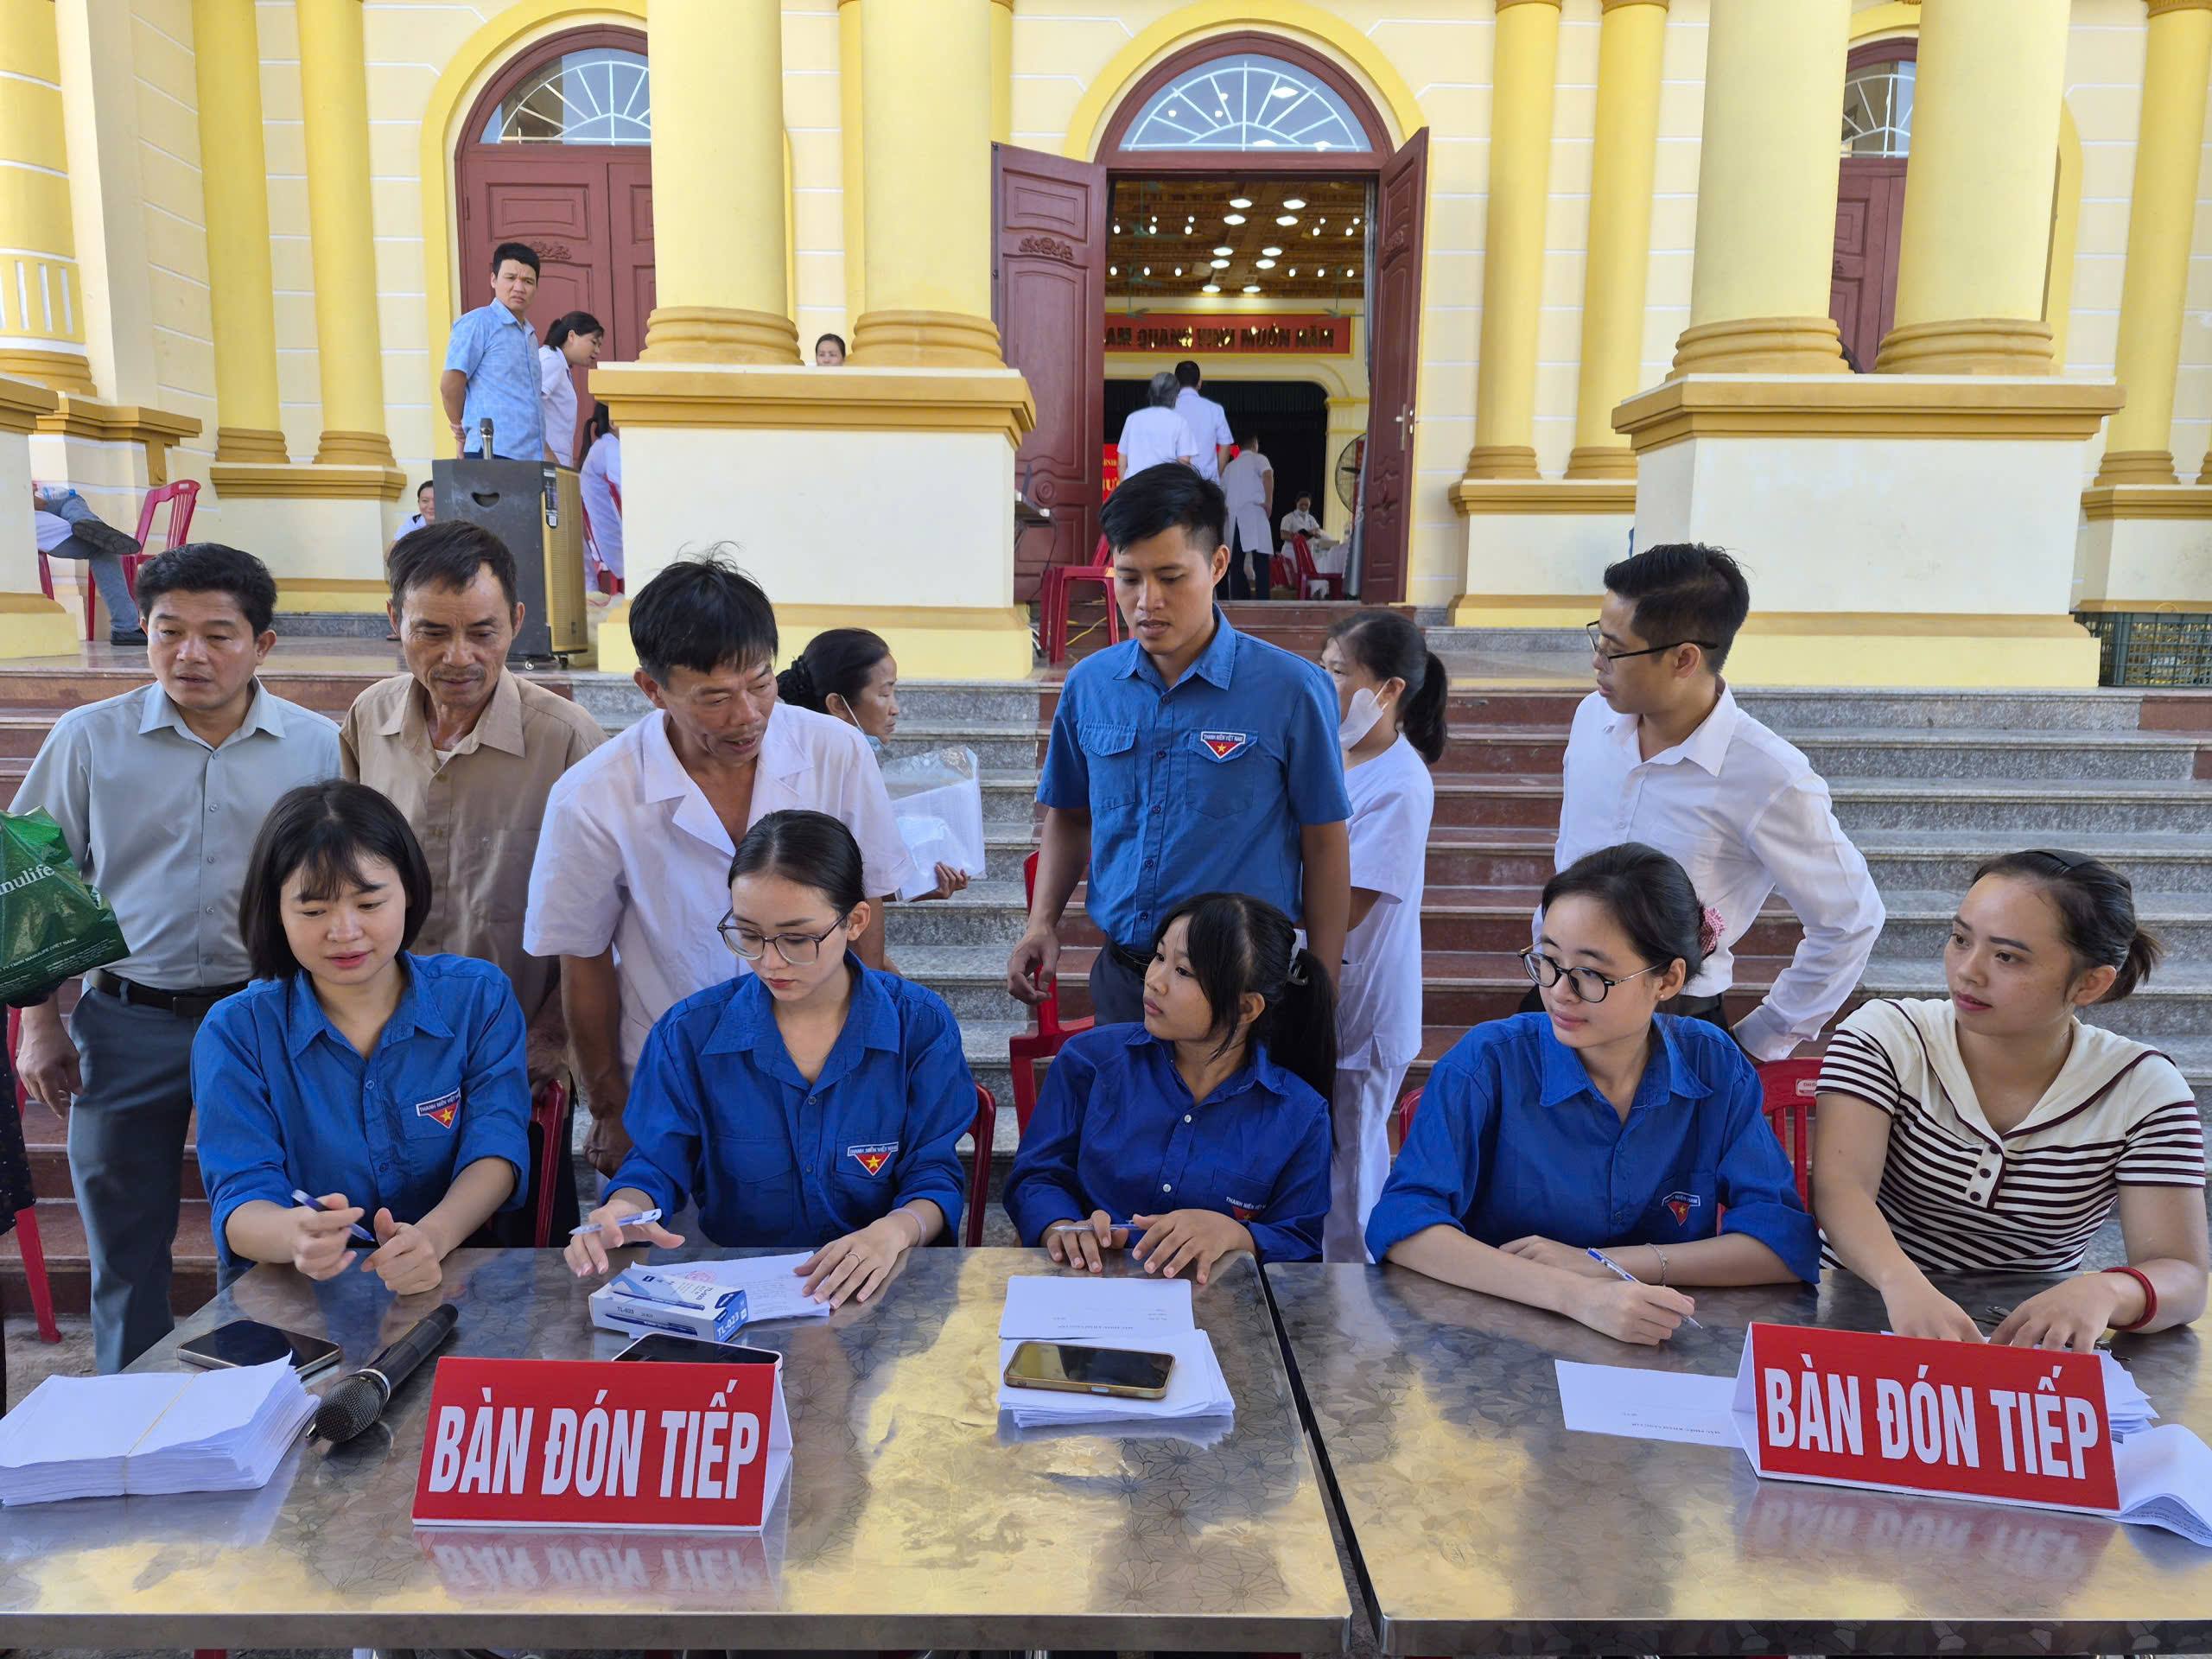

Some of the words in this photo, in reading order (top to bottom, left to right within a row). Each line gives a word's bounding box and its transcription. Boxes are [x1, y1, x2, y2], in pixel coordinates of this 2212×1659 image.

[1137, 327, 1192, 348] QUANG
[0, 864, 55, 896] nulife
[717, 1312, 740, 1338] TL-023
[1763, 1353, 1865, 1456] BÀN
[1876, 1364, 1980, 1468] ĐÓN
[1990, 1365, 2099, 1480] TIẾP
[428, 1387, 534, 1495] BÀN
[541, 1389, 646, 1498] ĐÓN
[659, 1379, 760, 1499] TIẾP
